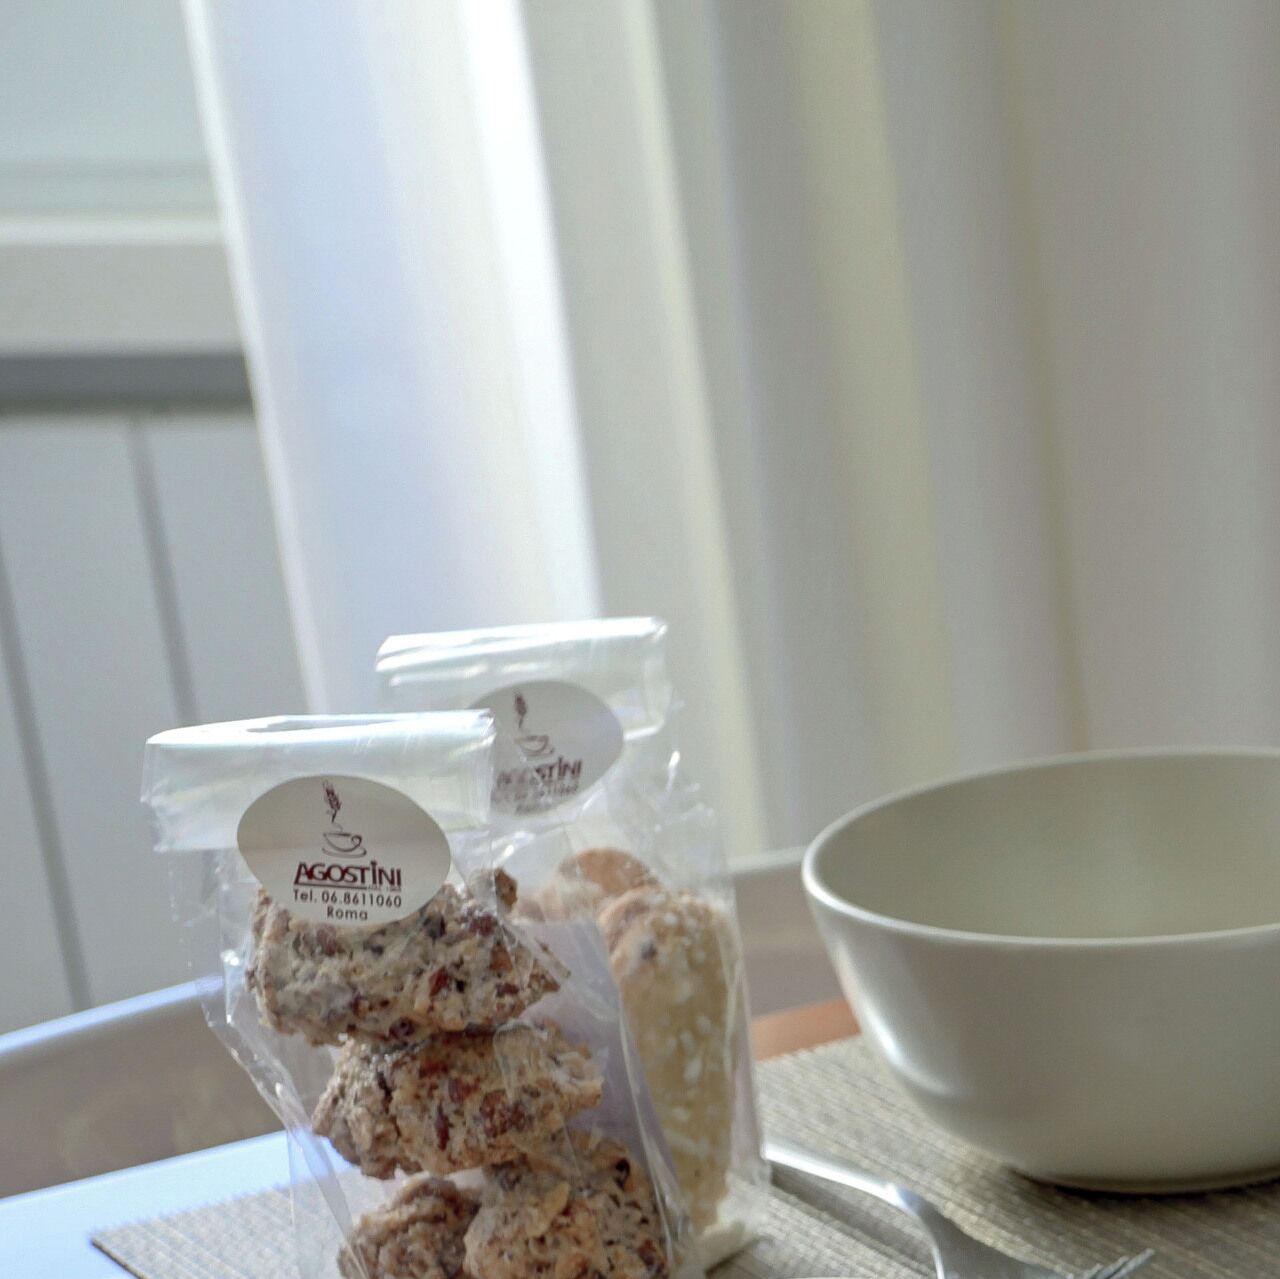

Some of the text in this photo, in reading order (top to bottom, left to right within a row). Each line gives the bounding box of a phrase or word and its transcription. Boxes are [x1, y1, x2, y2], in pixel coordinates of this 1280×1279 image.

[293, 860, 403, 887] AGOSTINI
[293, 889, 318, 904] Tel.
[327, 905, 369, 921] Roma
